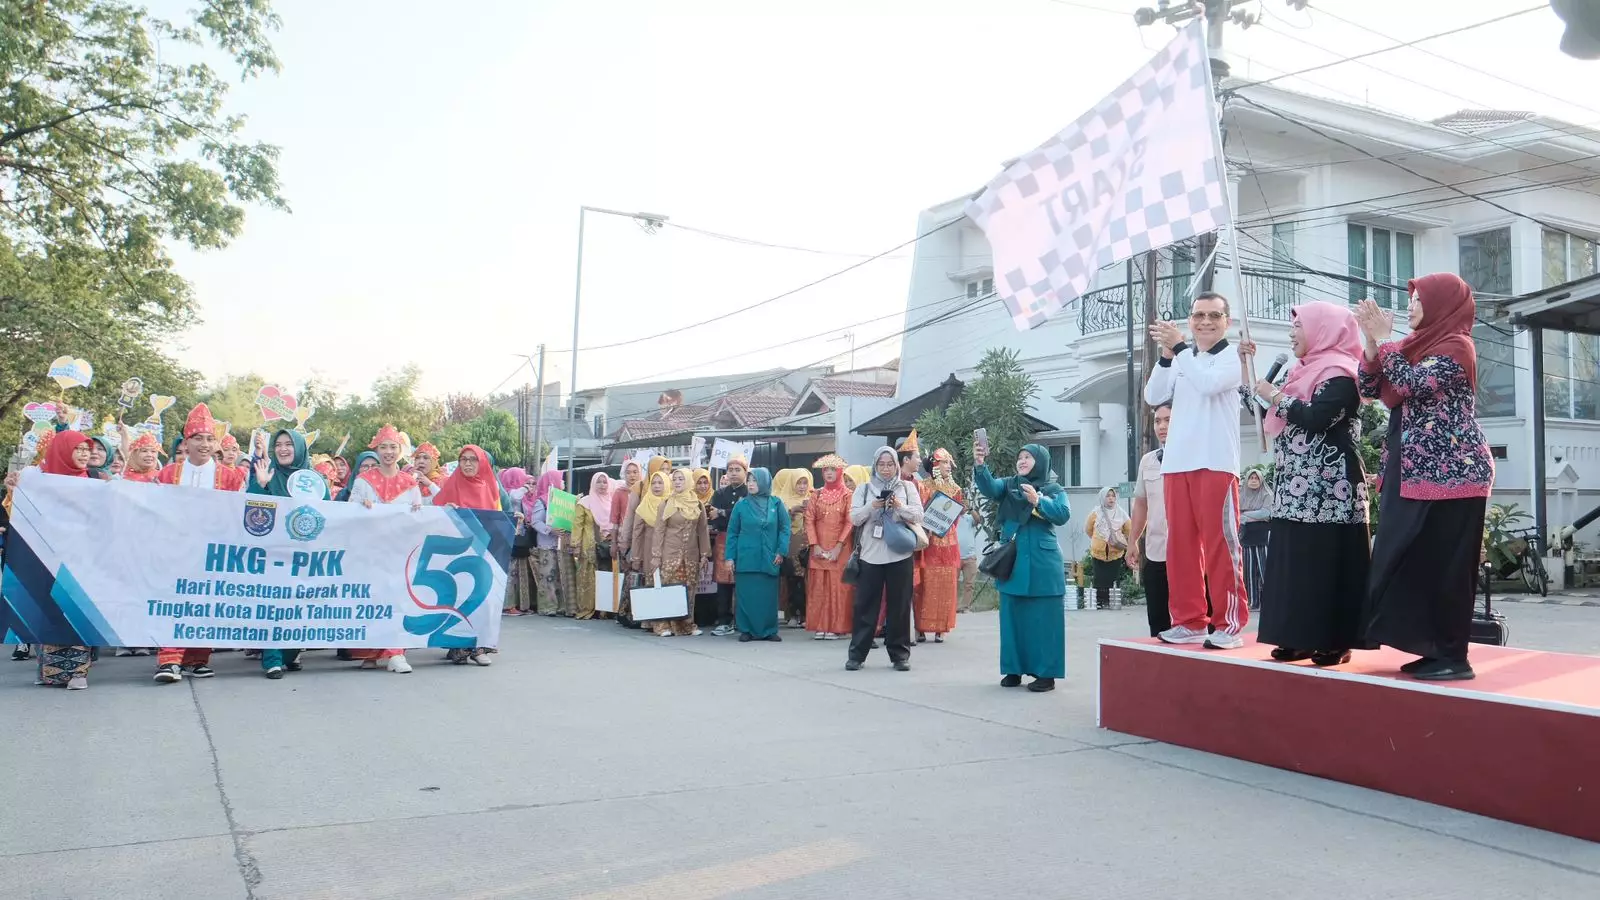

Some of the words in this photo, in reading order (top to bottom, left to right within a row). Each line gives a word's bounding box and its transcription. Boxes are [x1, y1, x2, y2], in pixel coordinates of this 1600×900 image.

[205, 543, 267, 574] HKG
[291, 550, 346, 577] PKK
[176, 578, 211, 595] Hari
[214, 580, 292, 599] Kesatuan
[295, 583, 338, 599] Gerak
[341, 583, 371, 598] PKK
[402, 534, 494, 648] 52
[147, 599, 211, 618] Tingkat
[214, 602, 252, 619] Kota
[255, 604, 303, 622] DEpok
[306, 604, 352, 619] Tahun
[355, 604, 392, 619] 2024
[173, 623, 269, 641] Kecamatan
[271, 625, 366, 642] Boojongsari
